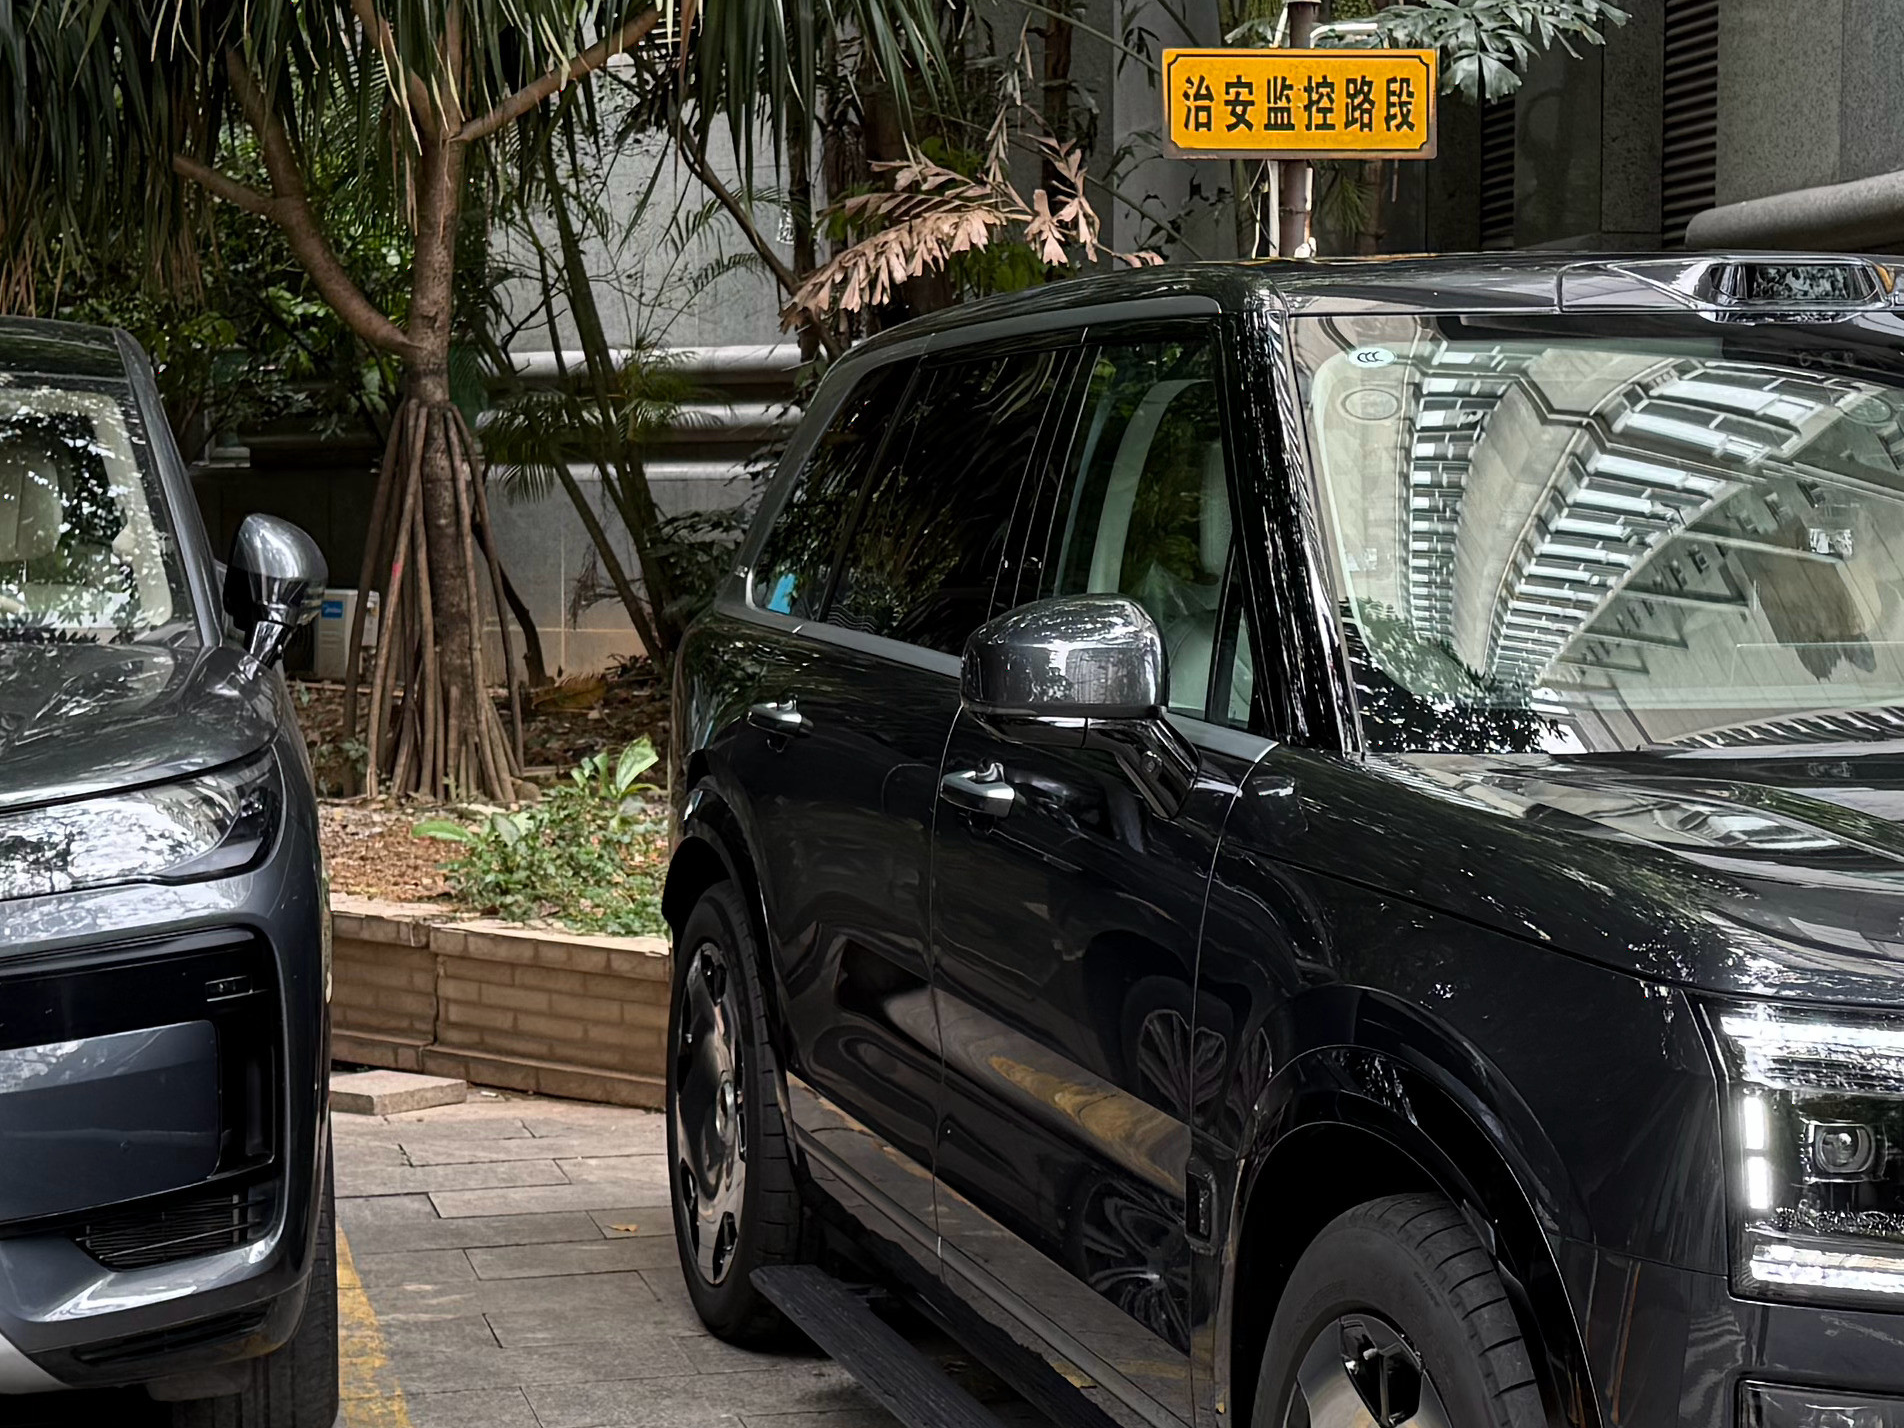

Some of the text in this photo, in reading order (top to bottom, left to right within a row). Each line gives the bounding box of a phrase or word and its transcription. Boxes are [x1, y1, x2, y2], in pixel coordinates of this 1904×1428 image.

[1182, 74, 1416, 132] 治安监控路段
